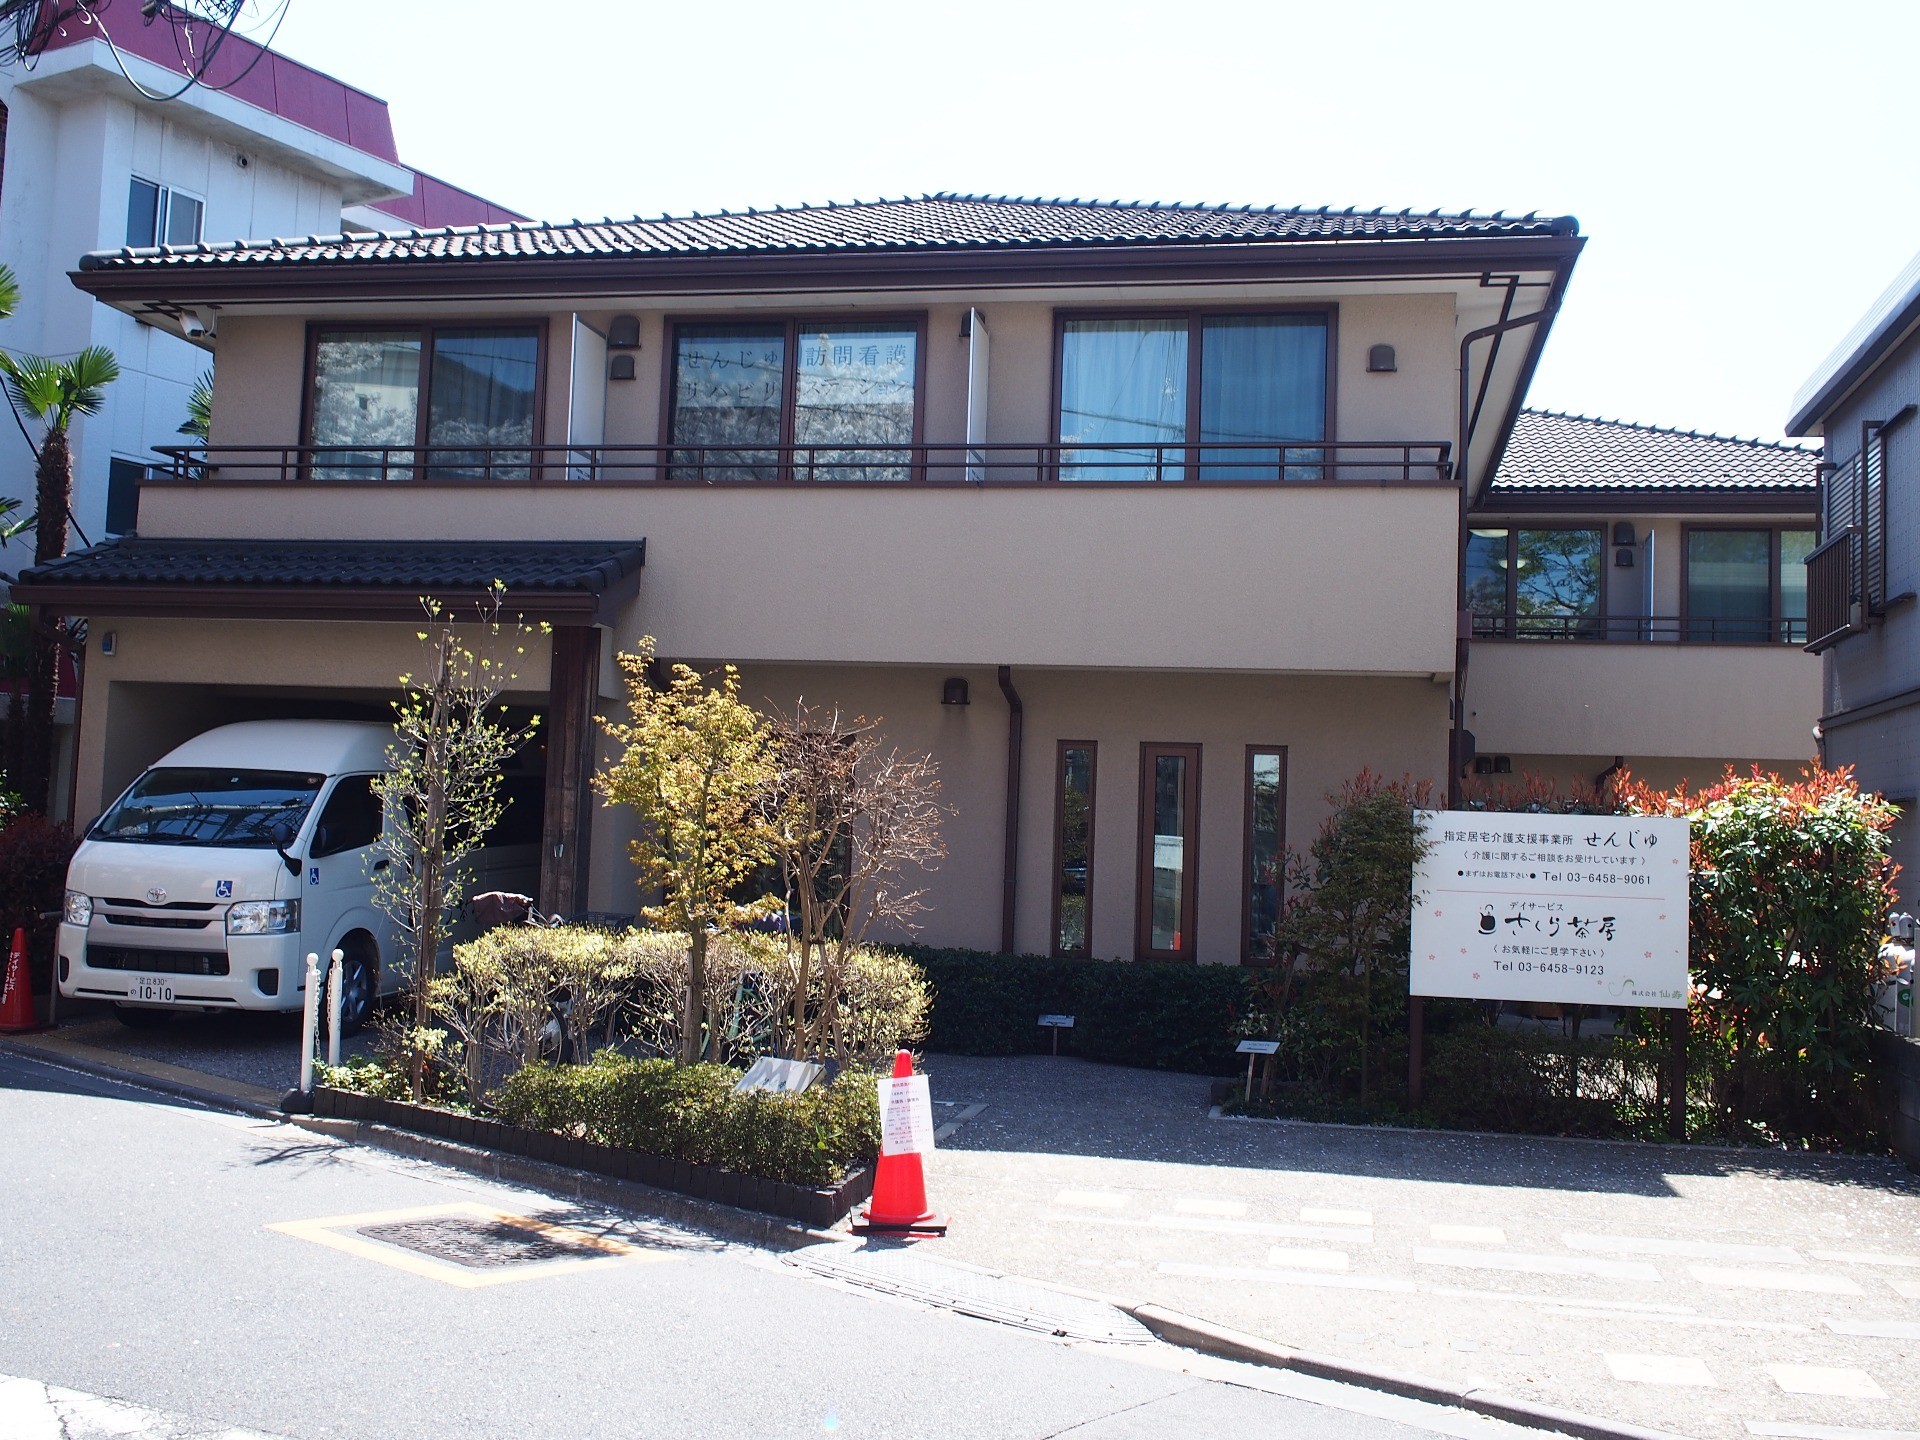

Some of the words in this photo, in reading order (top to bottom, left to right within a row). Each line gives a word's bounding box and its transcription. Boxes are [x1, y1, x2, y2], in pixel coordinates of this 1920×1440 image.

[685, 350, 778, 368] せんじゅ
[805, 345, 907, 367] 訪問看護
[687, 381, 776, 401] リハビリ
[803, 378, 907, 397] ステーション
[1444, 830, 1574, 846] 指定居宅介護支援事業所
[1583, 829, 1659, 850] せんじゅ
[1542, 871, 1563, 882] Tel
[1566, 872, 1652, 885] 03-6458-9061
[1509, 901, 1564, 912] デイサービス
[1504, 912, 1616, 942] さくら茶房
[8, 952, 21, 991] デイサービス
[1493, 960, 1514, 972] Tel
[1517, 962, 1605, 976] 03-6458-9123
[139, 985, 172, 1001] 10-10
[1631, 990, 1657, 998] 株式会社
